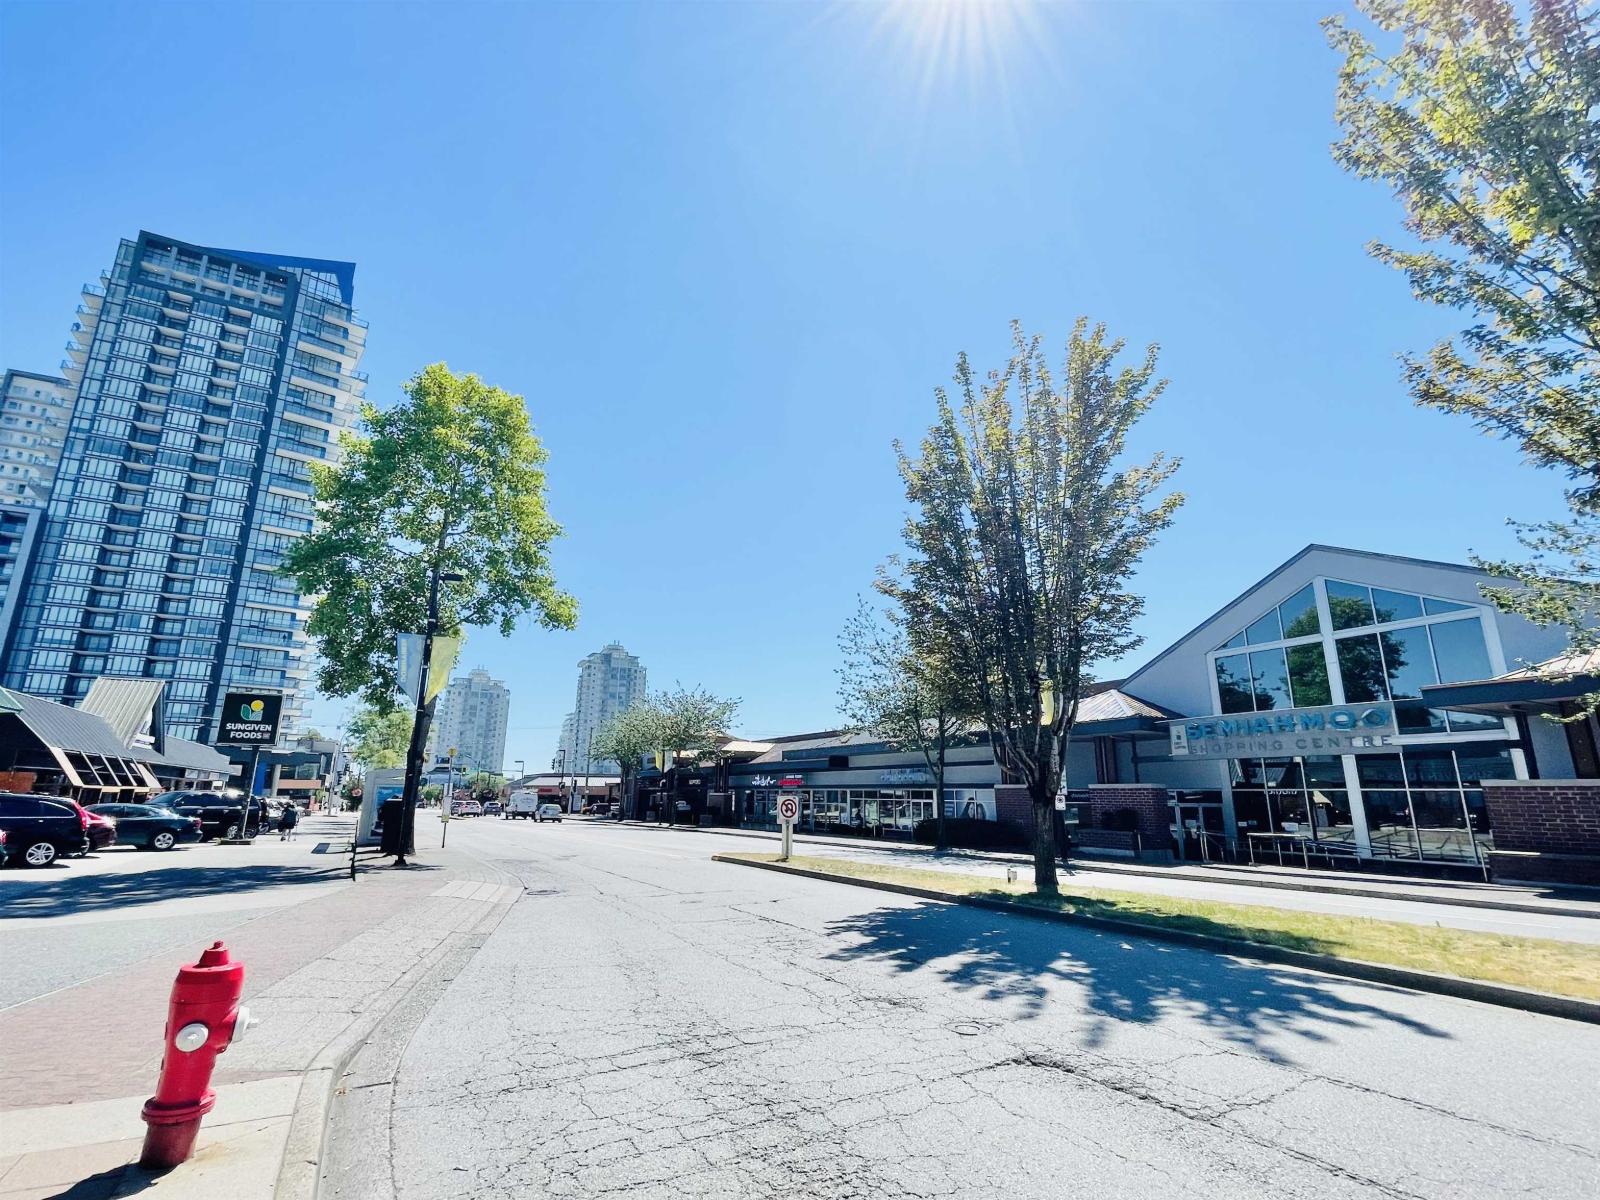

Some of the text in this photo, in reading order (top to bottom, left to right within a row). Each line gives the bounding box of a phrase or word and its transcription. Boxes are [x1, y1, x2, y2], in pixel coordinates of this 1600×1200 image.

[226, 723, 272, 731] SUNGIVEN
[1187, 708, 1390, 740] SEMIAHMOO
[230, 731, 262, 739] FOODS
[1189, 740, 1283, 754] SHOPPING
[1296, 735, 1392, 750] CENTRE
